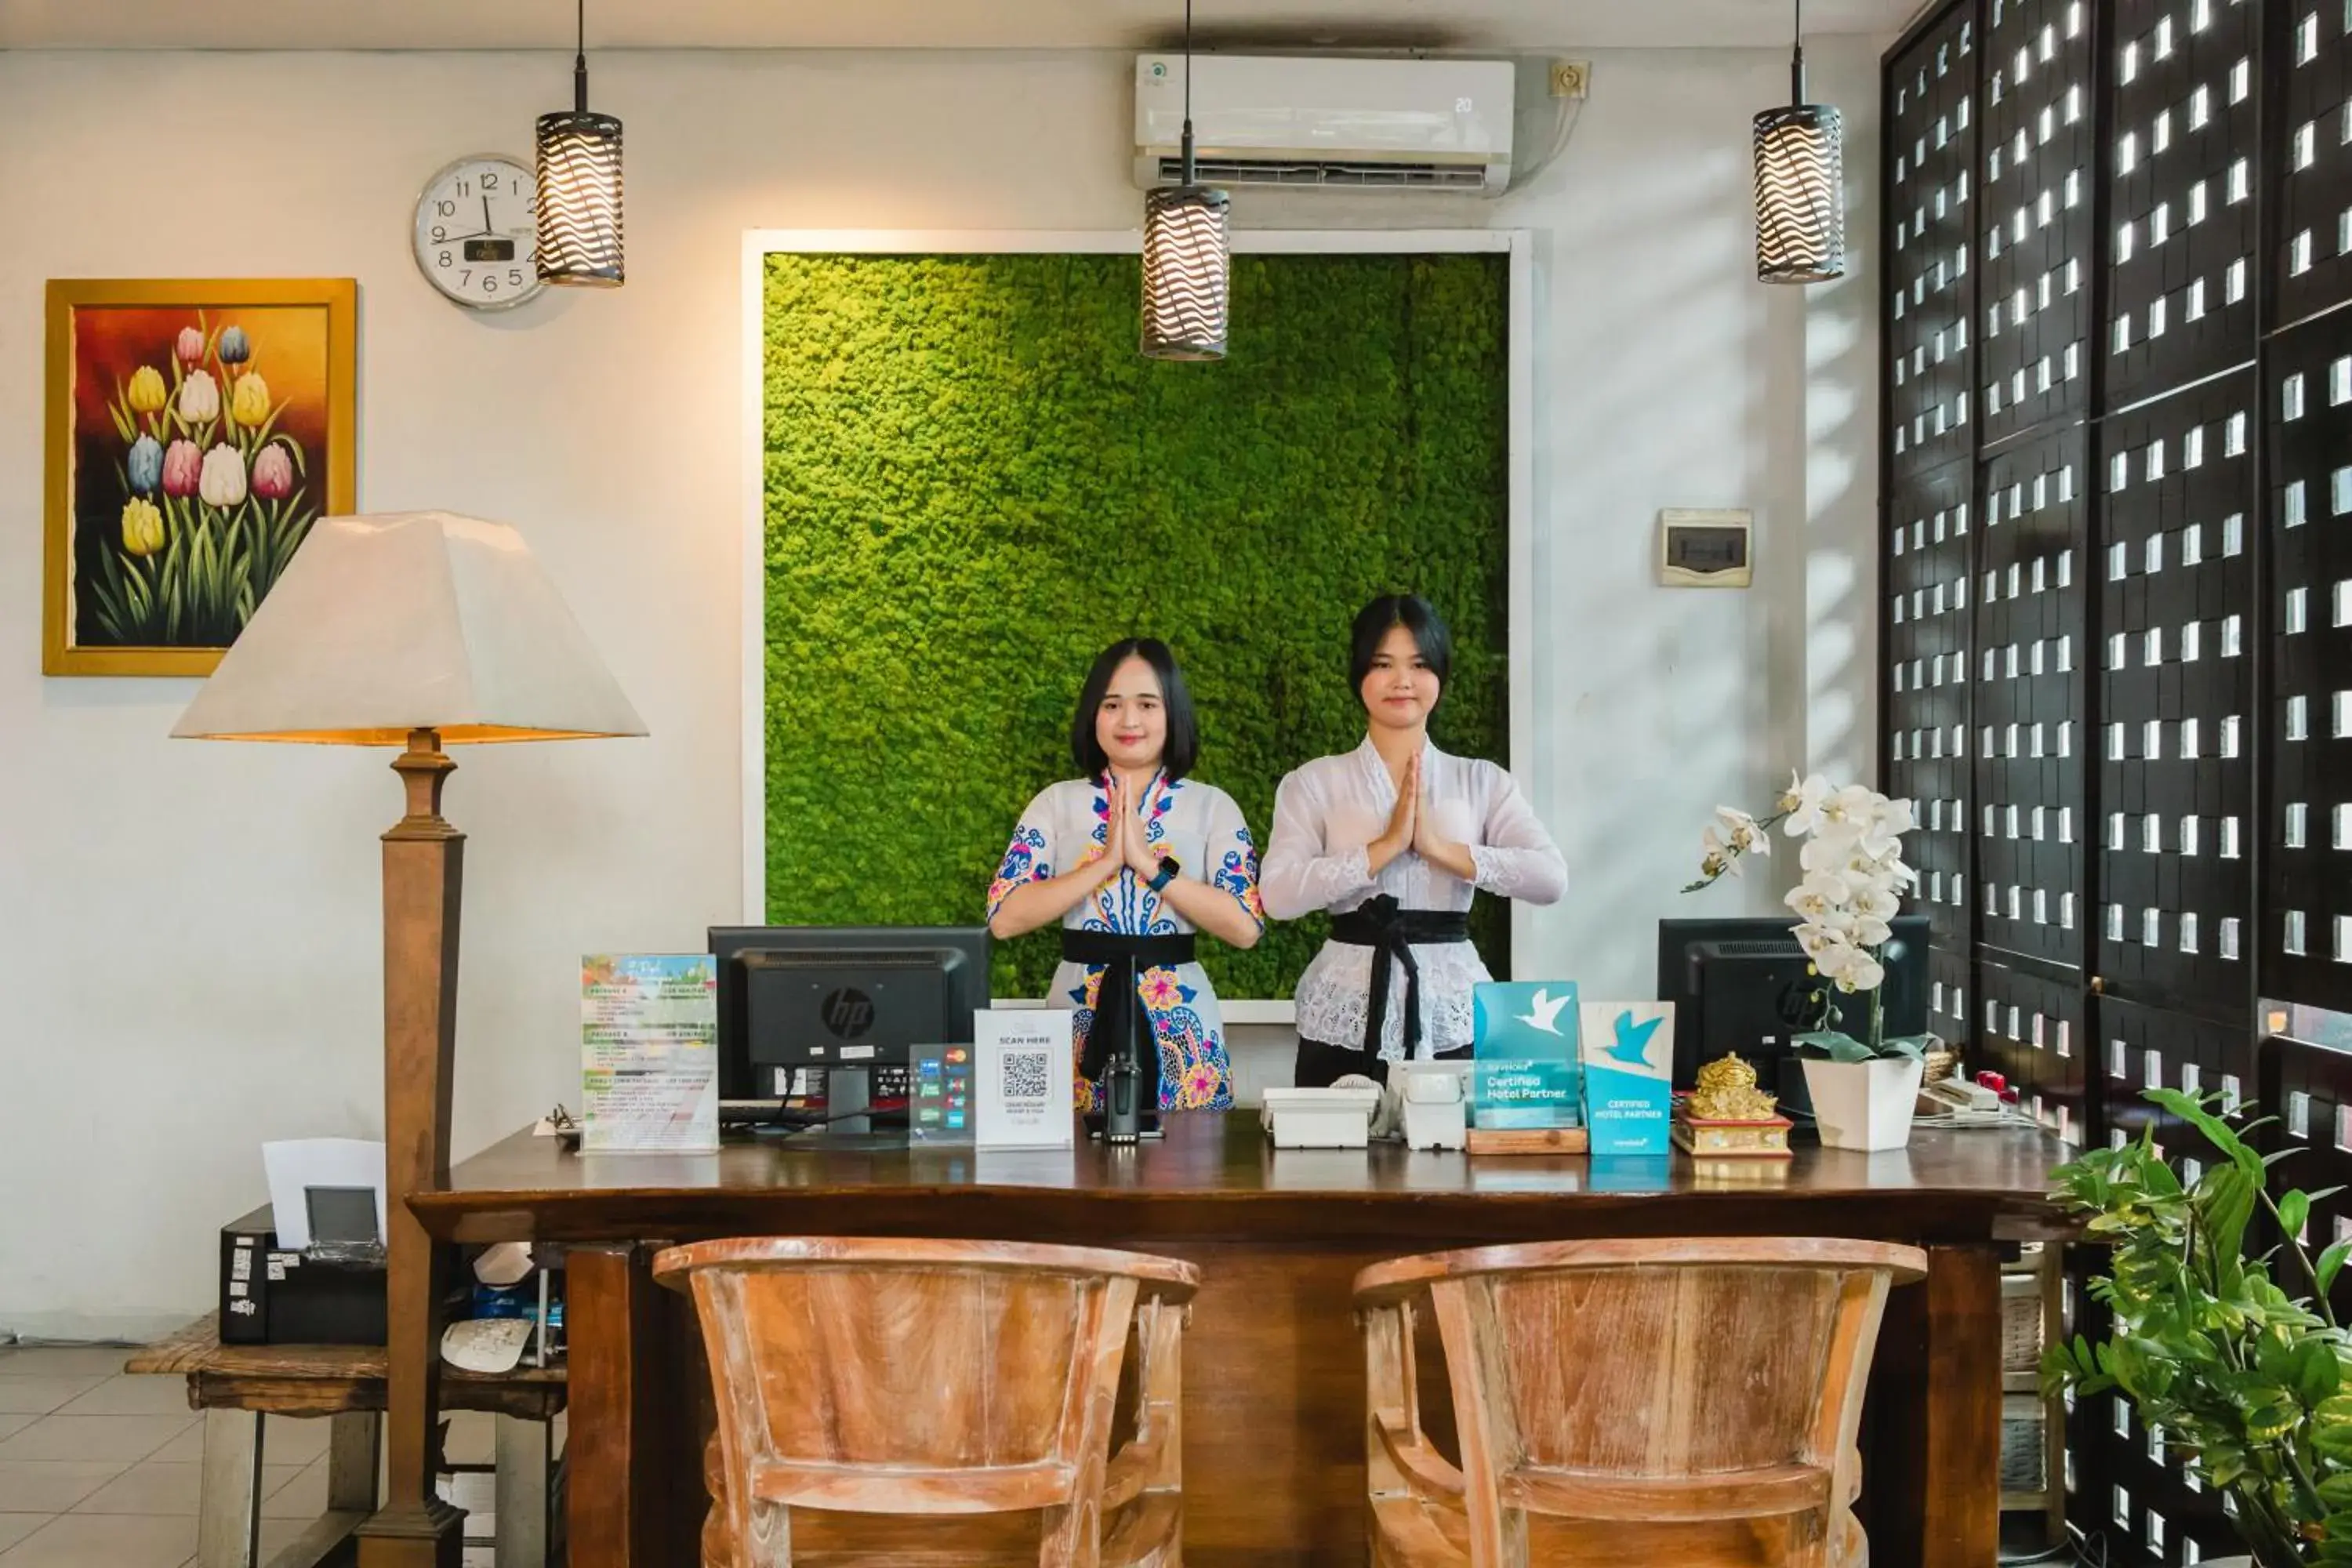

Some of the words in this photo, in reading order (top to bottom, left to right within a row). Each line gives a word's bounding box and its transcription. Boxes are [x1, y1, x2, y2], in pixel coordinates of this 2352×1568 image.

[1455, 97, 1473, 114] 20
[456, 182, 470, 197] 11
[480, 173, 499, 190] 12
[512, 180, 518, 195] 1
[437, 200, 456, 216] 10
[526, 197, 537, 215] 2
[431, 226, 446, 243] 9
[438, 251, 452, 267] 8
[459, 270, 472, 286] 7
[483, 275, 498, 292] 6
[509, 269, 523, 286] 5
[830, 987, 870, 1039] hp
[1486, 1075, 1541, 1087] Certified
[1486, 1089, 1520, 1099] Hotel
[1522, 1088, 1566, 1099] Partner
[1595, 1110, 1623, 1119] HOTEL
[1624, 1110, 1663, 1119] PARTNER
